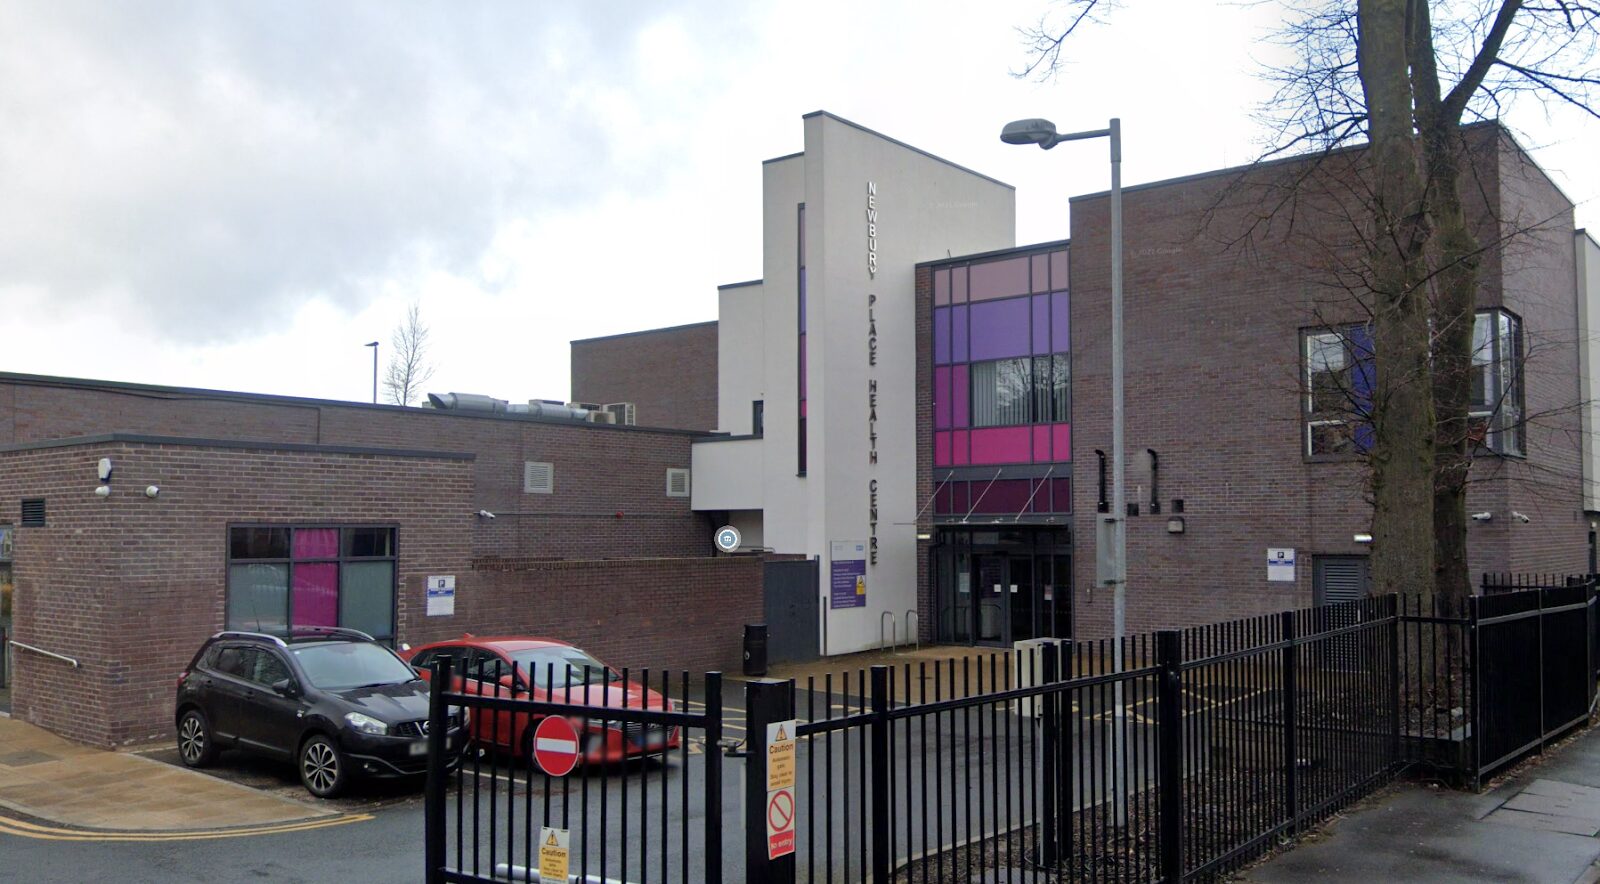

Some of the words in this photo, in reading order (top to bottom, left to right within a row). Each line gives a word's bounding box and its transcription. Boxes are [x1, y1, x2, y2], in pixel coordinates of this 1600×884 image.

[867, 181, 877, 280] NEWBURY
[868, 294, 877, 366] PLACE
[868, 379, 878, 465] HEALTH
[868, 479, 878, 565] CENTRE
[769, 743, 794, 755] Caution
[541, 848, 566, 857] Caution
[779, 838, 793, 848] entry
